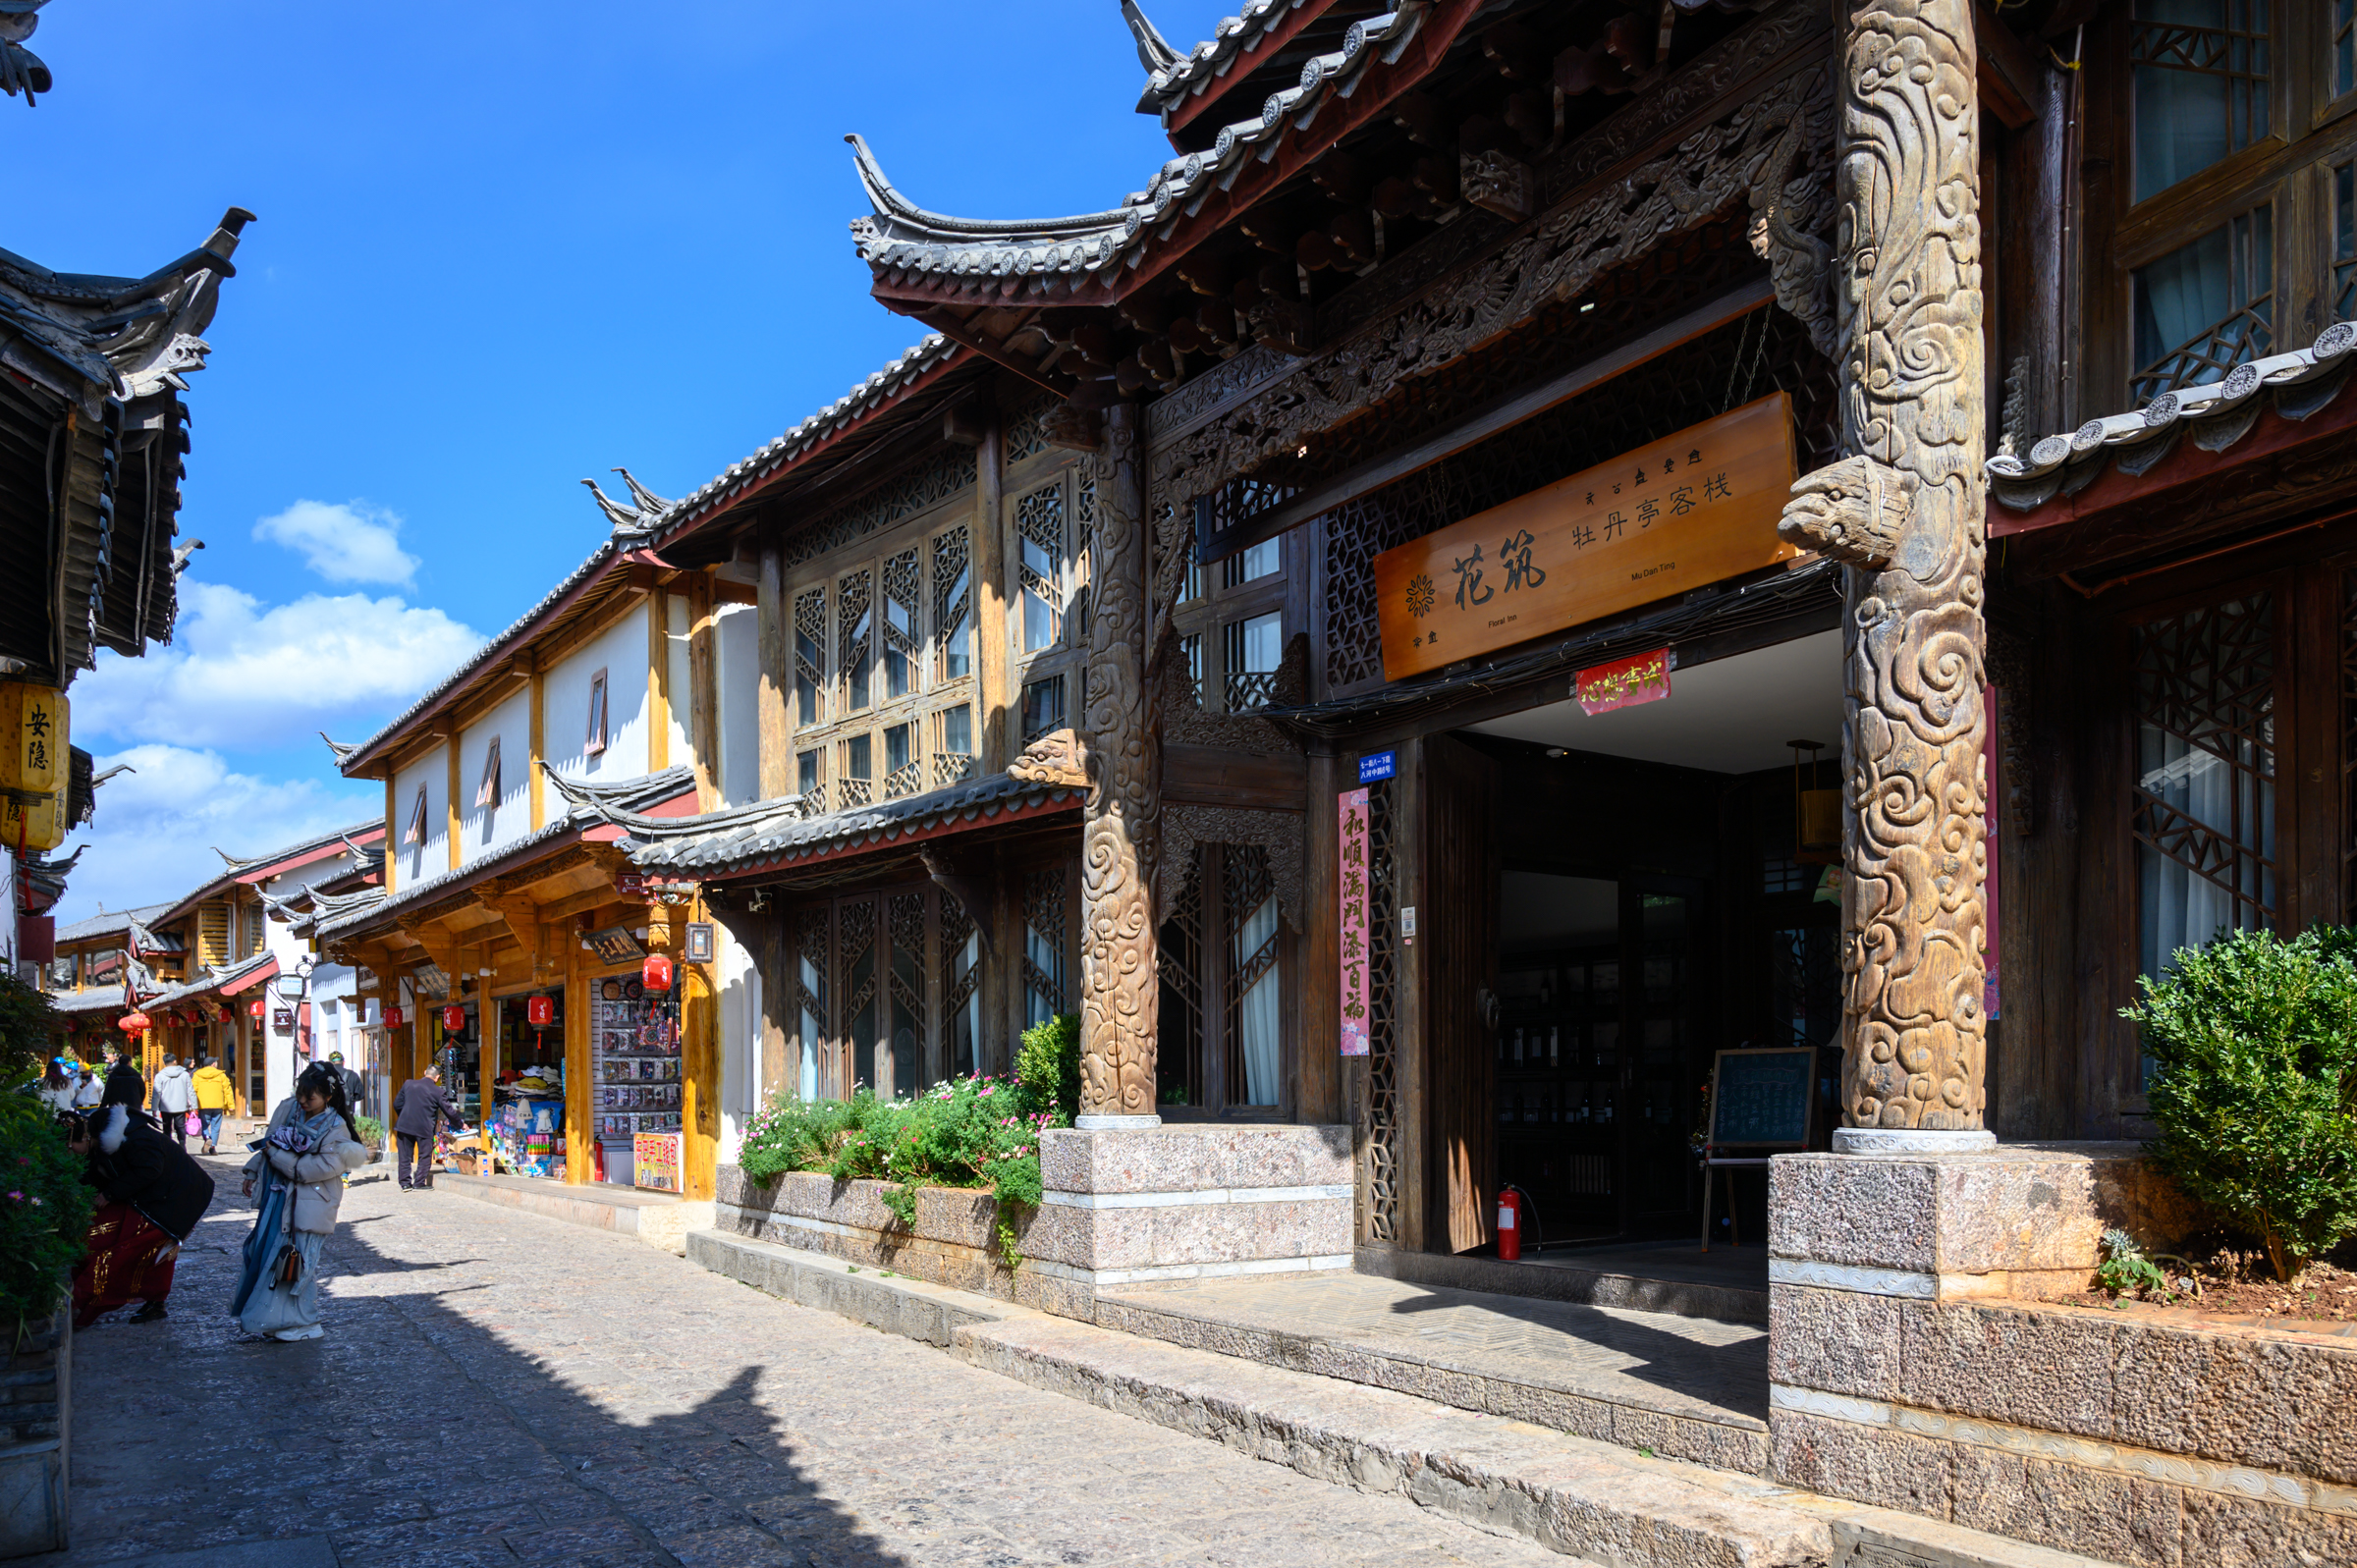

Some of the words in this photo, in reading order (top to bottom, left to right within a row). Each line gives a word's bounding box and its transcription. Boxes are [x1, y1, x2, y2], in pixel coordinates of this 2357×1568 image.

[1571, 471, 1732, 550] 牡丹亭客栈
[1451, 528, 1547, 612] 花筑
[1631, 572, 1642, 581] Mu
[1643, 568, 1658, 577] Dan
[1659, 562, 1675, 571] Ting
[1488, 617, 1506, 628] Floral
[1507, 614, 1517, 622] Inn
[1580, 660, 1665, 703] 心想事成
[25, 703, 51, 771] 安隐
